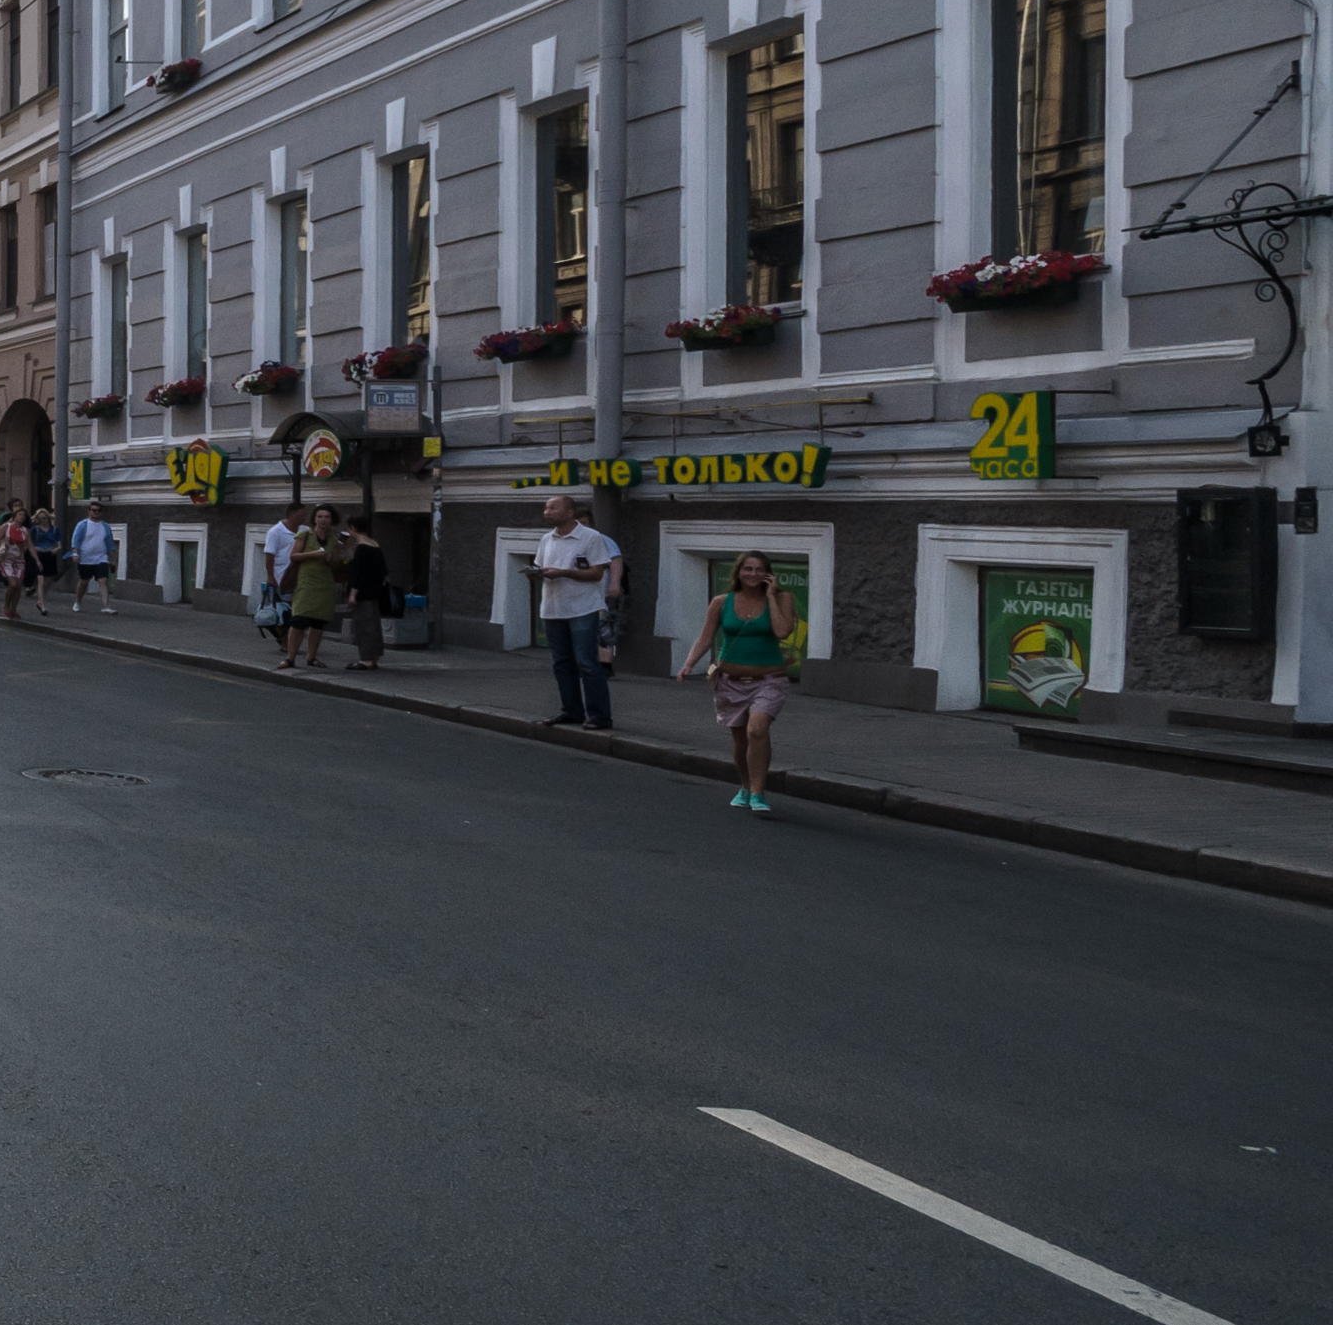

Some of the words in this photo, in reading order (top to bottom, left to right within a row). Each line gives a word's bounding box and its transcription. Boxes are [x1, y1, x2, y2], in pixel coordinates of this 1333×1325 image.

[970, 392, 1039, 458] 24
[589, 459, 631, 487] не
[970, 459, 1038, 479] часа
[1016, 580, 1084, 598] ГАЗЕТЫ
